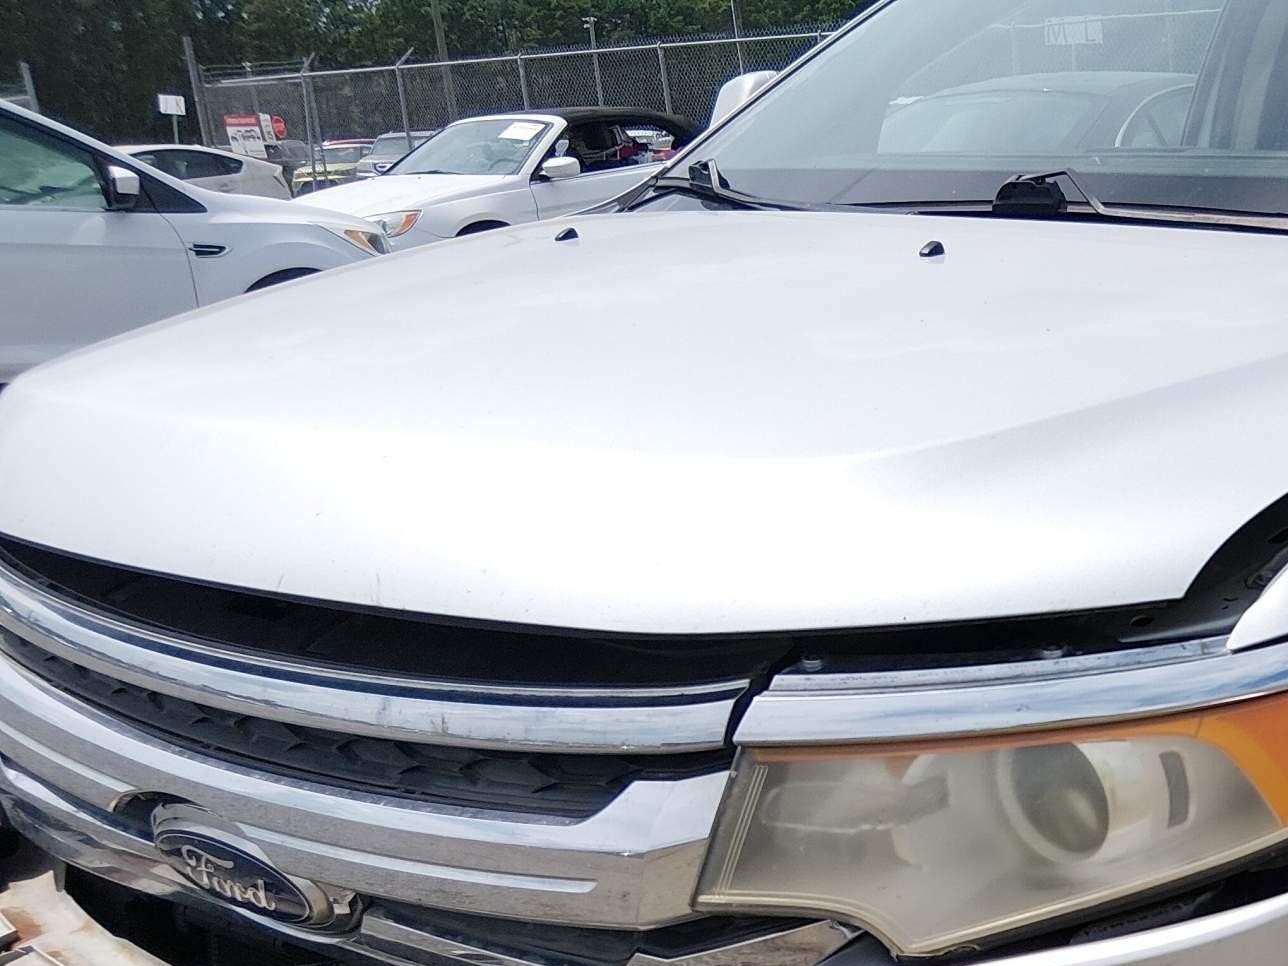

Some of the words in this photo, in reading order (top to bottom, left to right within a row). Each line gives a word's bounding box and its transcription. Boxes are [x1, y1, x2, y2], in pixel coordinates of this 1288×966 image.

[1047, 18, 1067, 44] M
[1084, 17, 1097, 42] L
[181, 844, 276, 911] Ford
